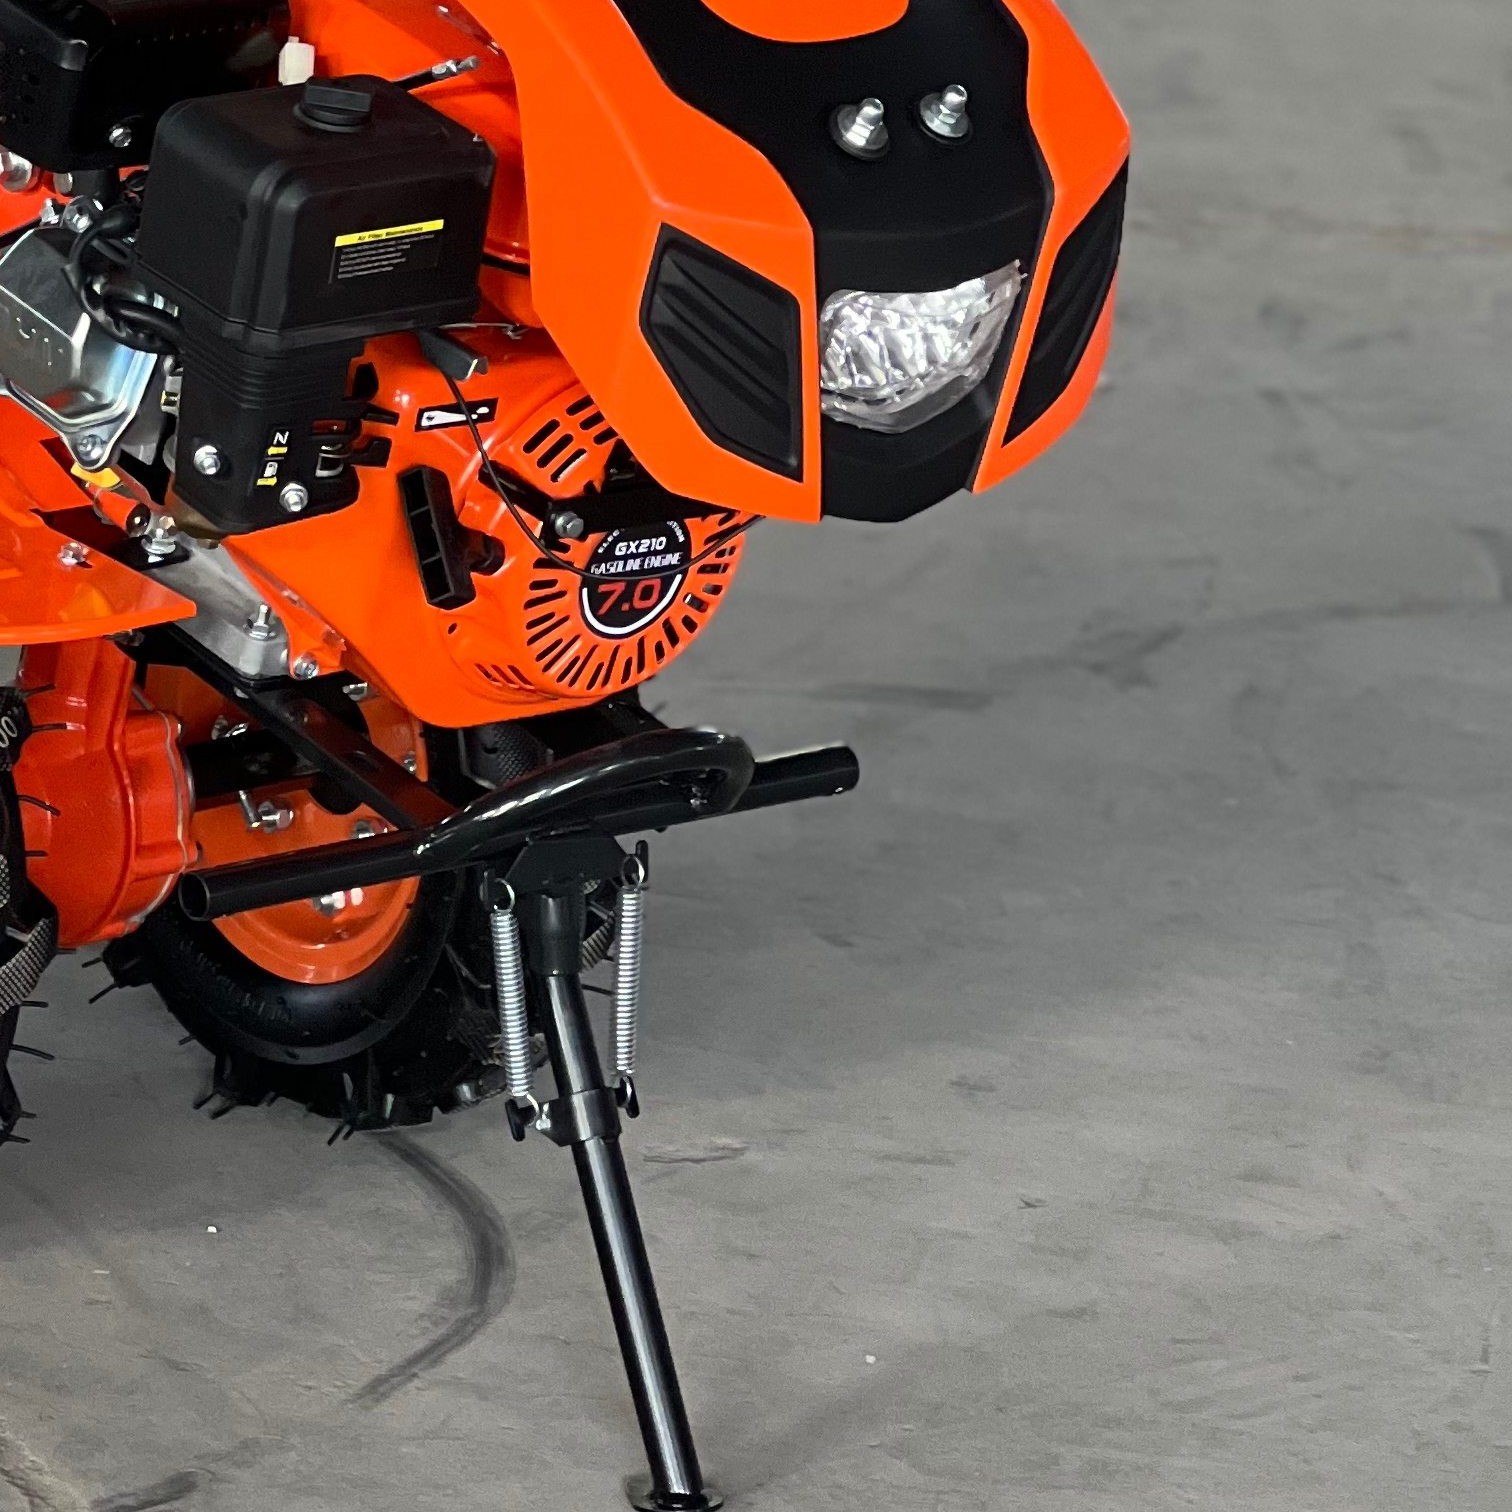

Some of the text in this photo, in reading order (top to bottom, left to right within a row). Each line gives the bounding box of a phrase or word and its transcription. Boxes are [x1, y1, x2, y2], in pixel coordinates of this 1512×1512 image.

[614, 536, 667, 556] GX210
[590, 551, 683, 575] GASOLINE ENGINE
[597, 578, 662, 616] 7.0
